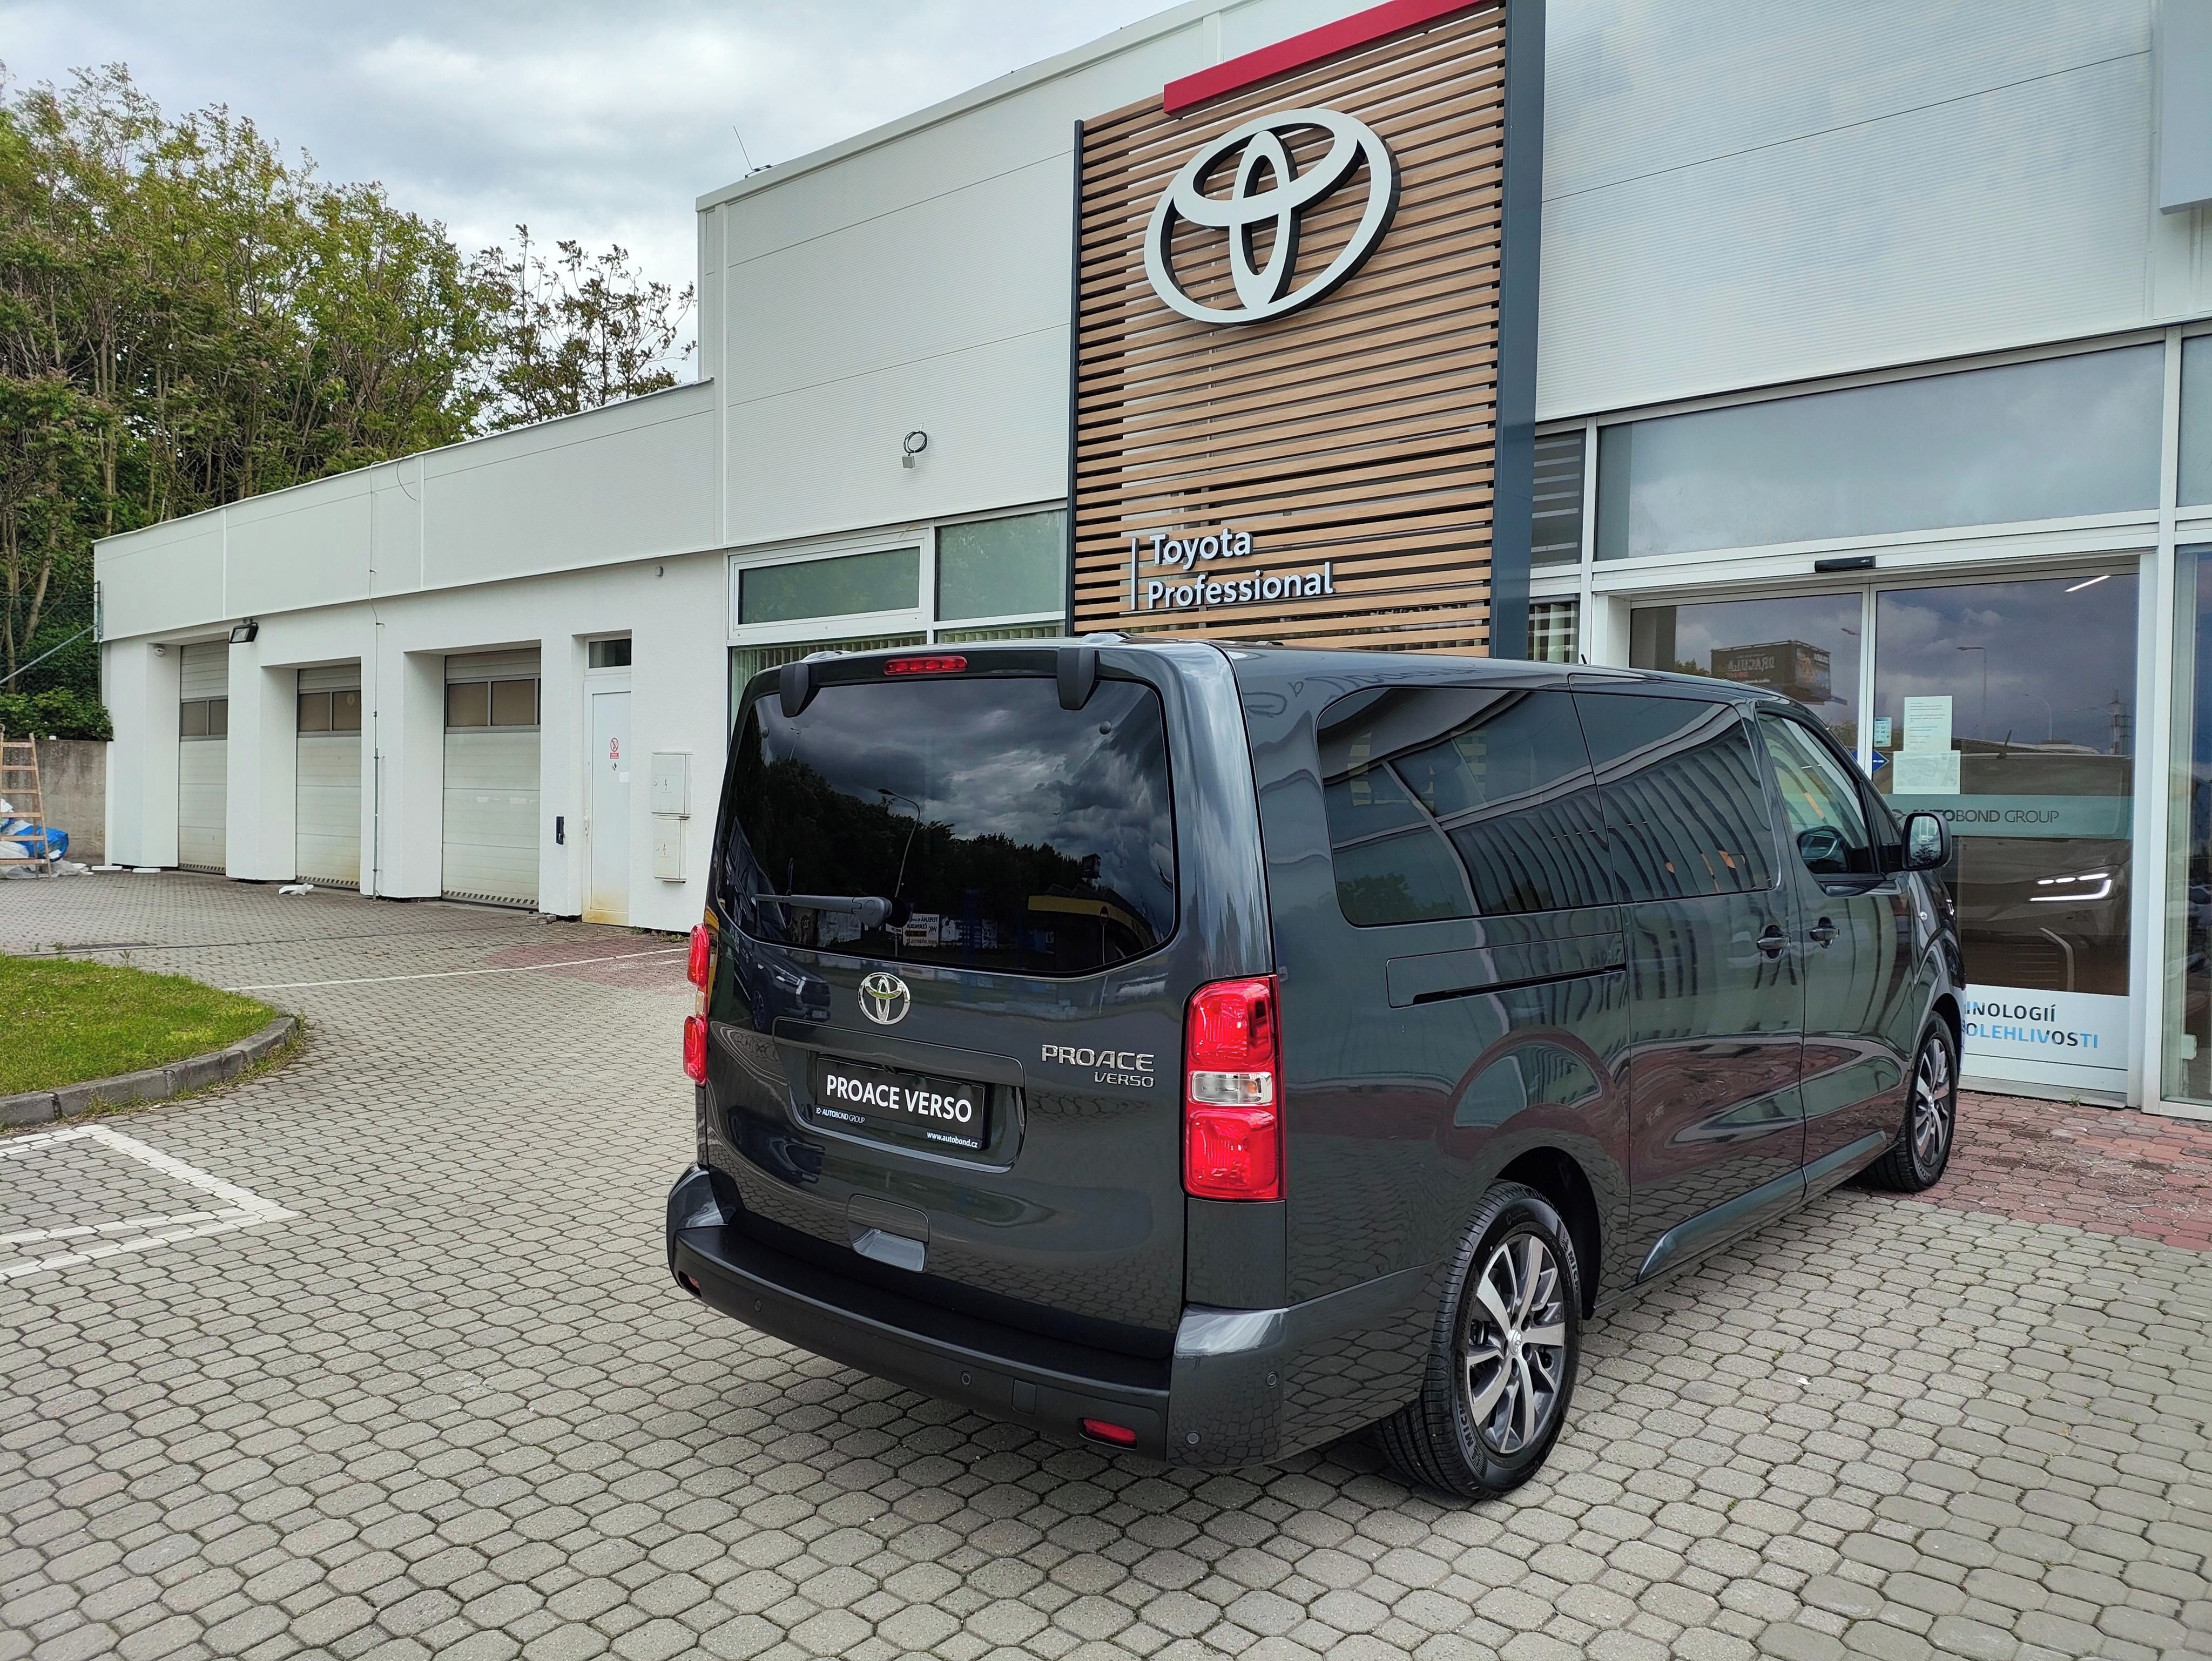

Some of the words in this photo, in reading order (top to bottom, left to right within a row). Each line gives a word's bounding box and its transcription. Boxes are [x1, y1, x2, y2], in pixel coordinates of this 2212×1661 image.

[1149, 527, 1252, 570] Toyota
[1148, 561, 1336, 609] Professional
[1913, 809, 2001, 822] OBOND
[2005, 810, 2059, 823] GROUP
[1966, 1022, 2098, 1049] OLEHLIVOSTI
[1042, 1044, 1155, 1073] PROACE
[1094, 1071, 1155, 1088] VERSO
[826, 1075, 900, 1110] PROACE
[905, 1089, 972, 1123] VERSO
[822, 1109, 848, 1120] AUTOBOND
[849, 1115, 865, 1124] GROUP
[927, 1132, 978, 1149] www.autobond.cz
